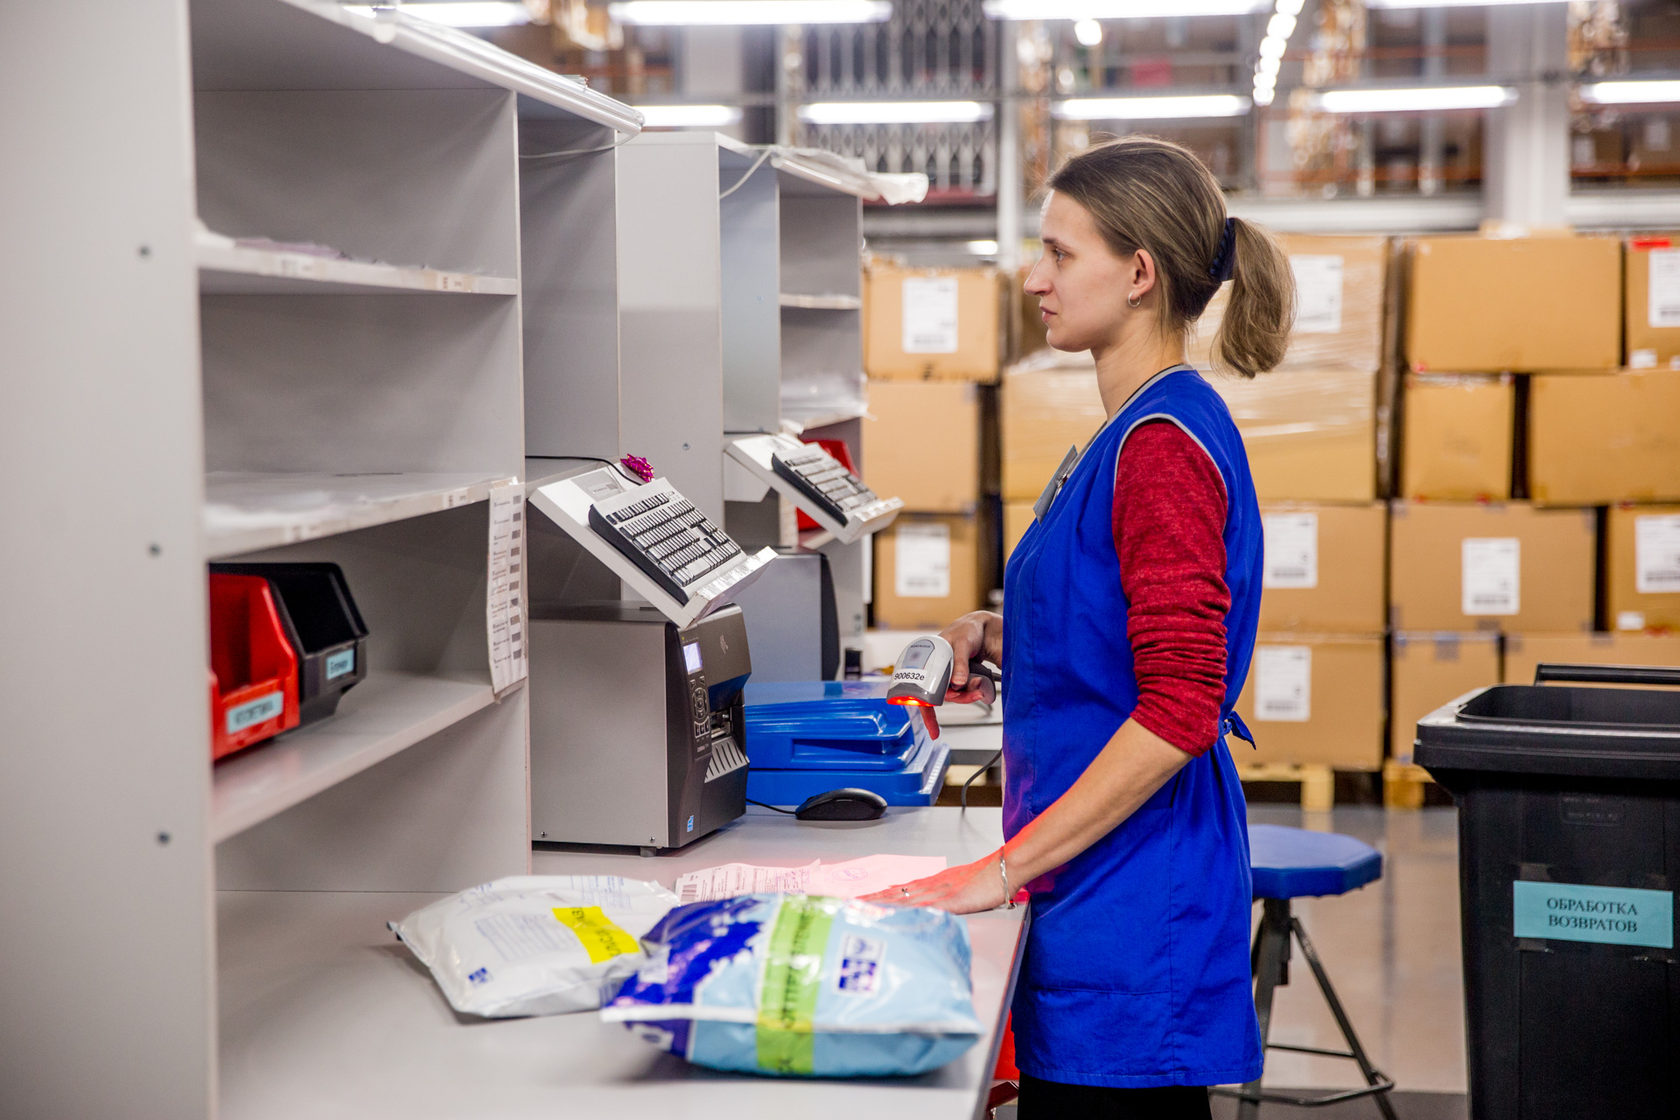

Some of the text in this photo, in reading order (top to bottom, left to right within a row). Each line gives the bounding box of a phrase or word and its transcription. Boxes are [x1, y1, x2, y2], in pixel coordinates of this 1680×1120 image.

[894, 672, 924, 680] 900632e
[1547, 897, 1637, 915] ОБРАБОТКА
[1549, 915, 1637, 932] ВОЗВРАТОВ
